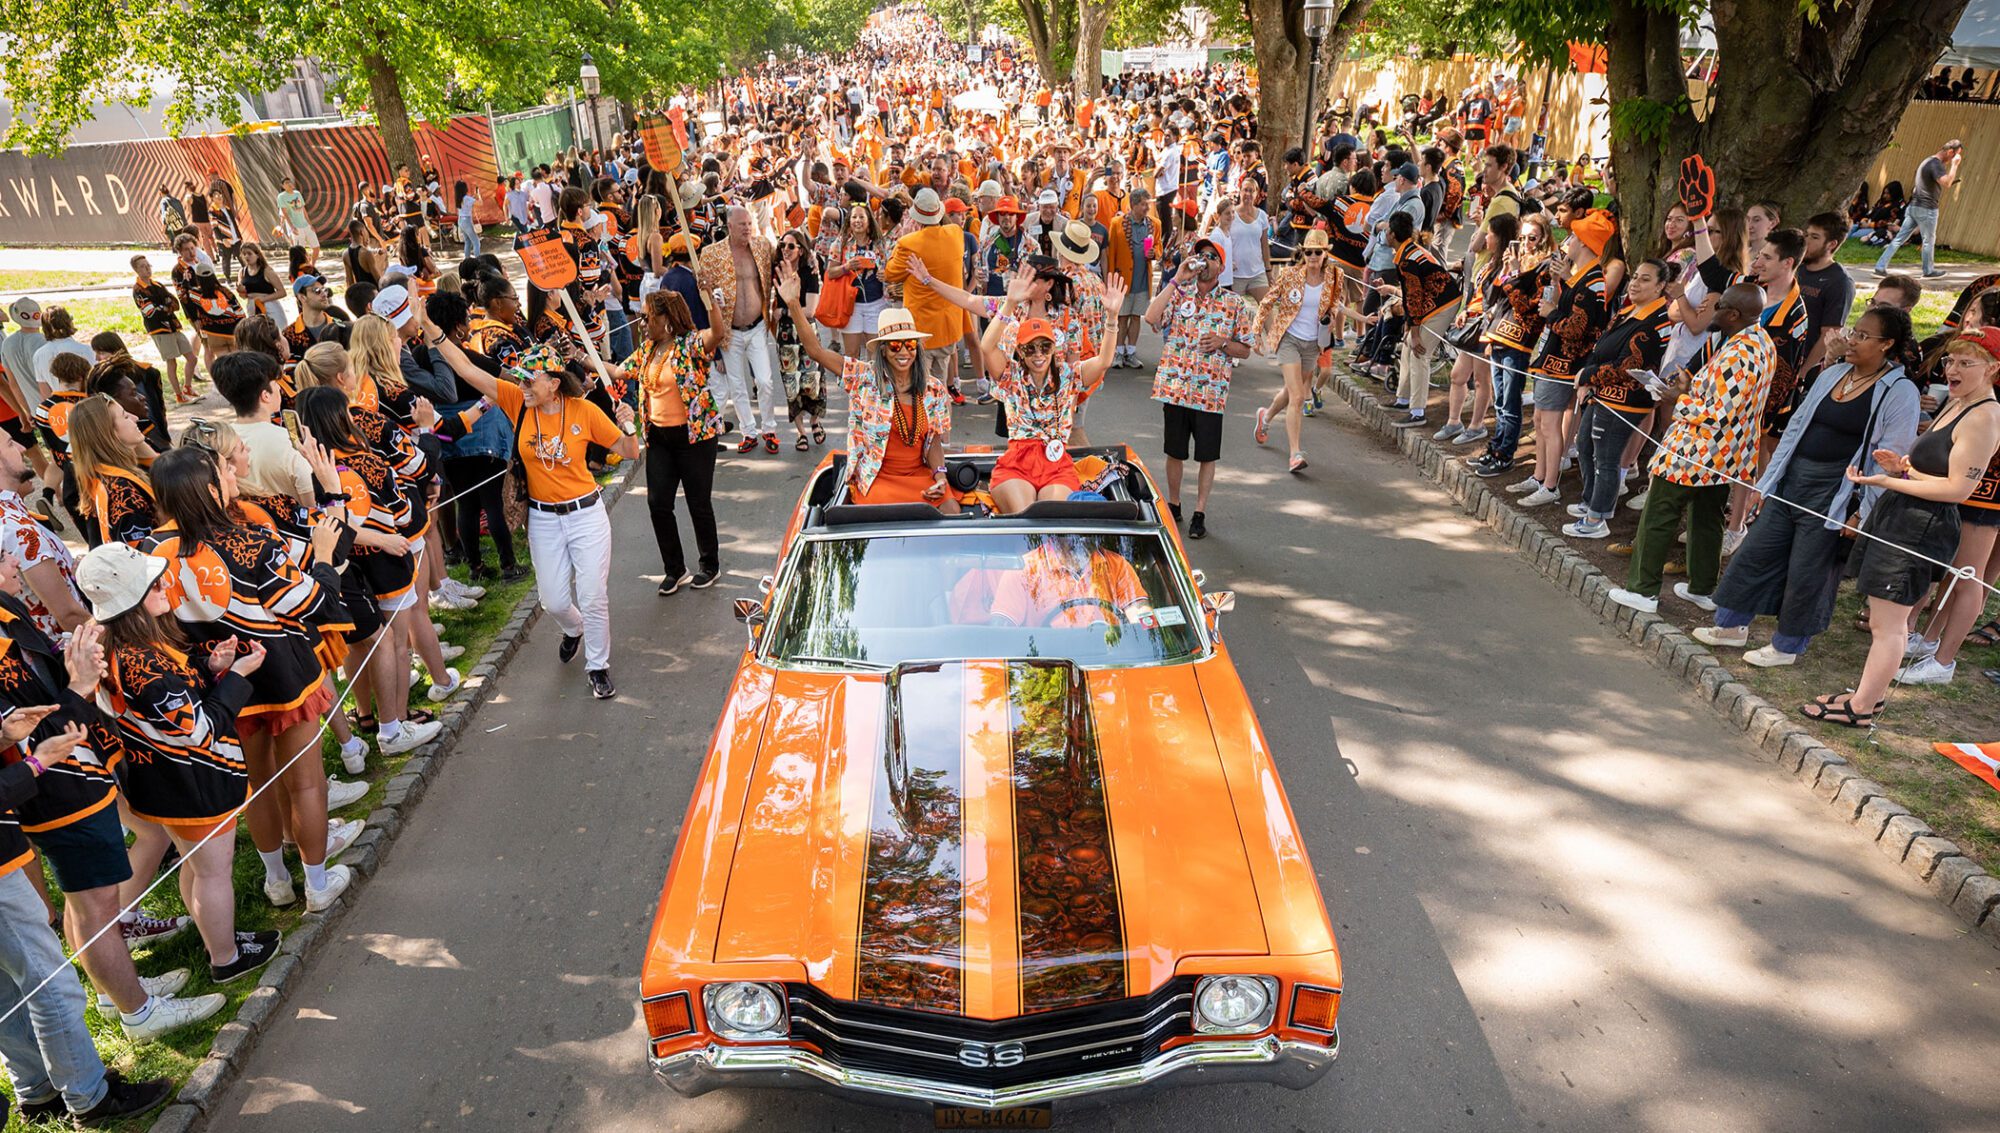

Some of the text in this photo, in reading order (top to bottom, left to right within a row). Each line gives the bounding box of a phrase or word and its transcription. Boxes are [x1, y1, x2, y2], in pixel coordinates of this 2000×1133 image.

[1499, 322, 1523, 339] 2023
[1546, 358, 1570, 373] 2023
[358, 391, 376, 408] 23
[1599, 386, 1624, 400] 2023
[50, 415, 65, 426] 20
[343, 483, 367, 502] 23
[197, 565, 227, 587] 23
[959, 1041, 1026, 1067] SS
[1082, 1047, 1133, 1060] CHEVELLE
